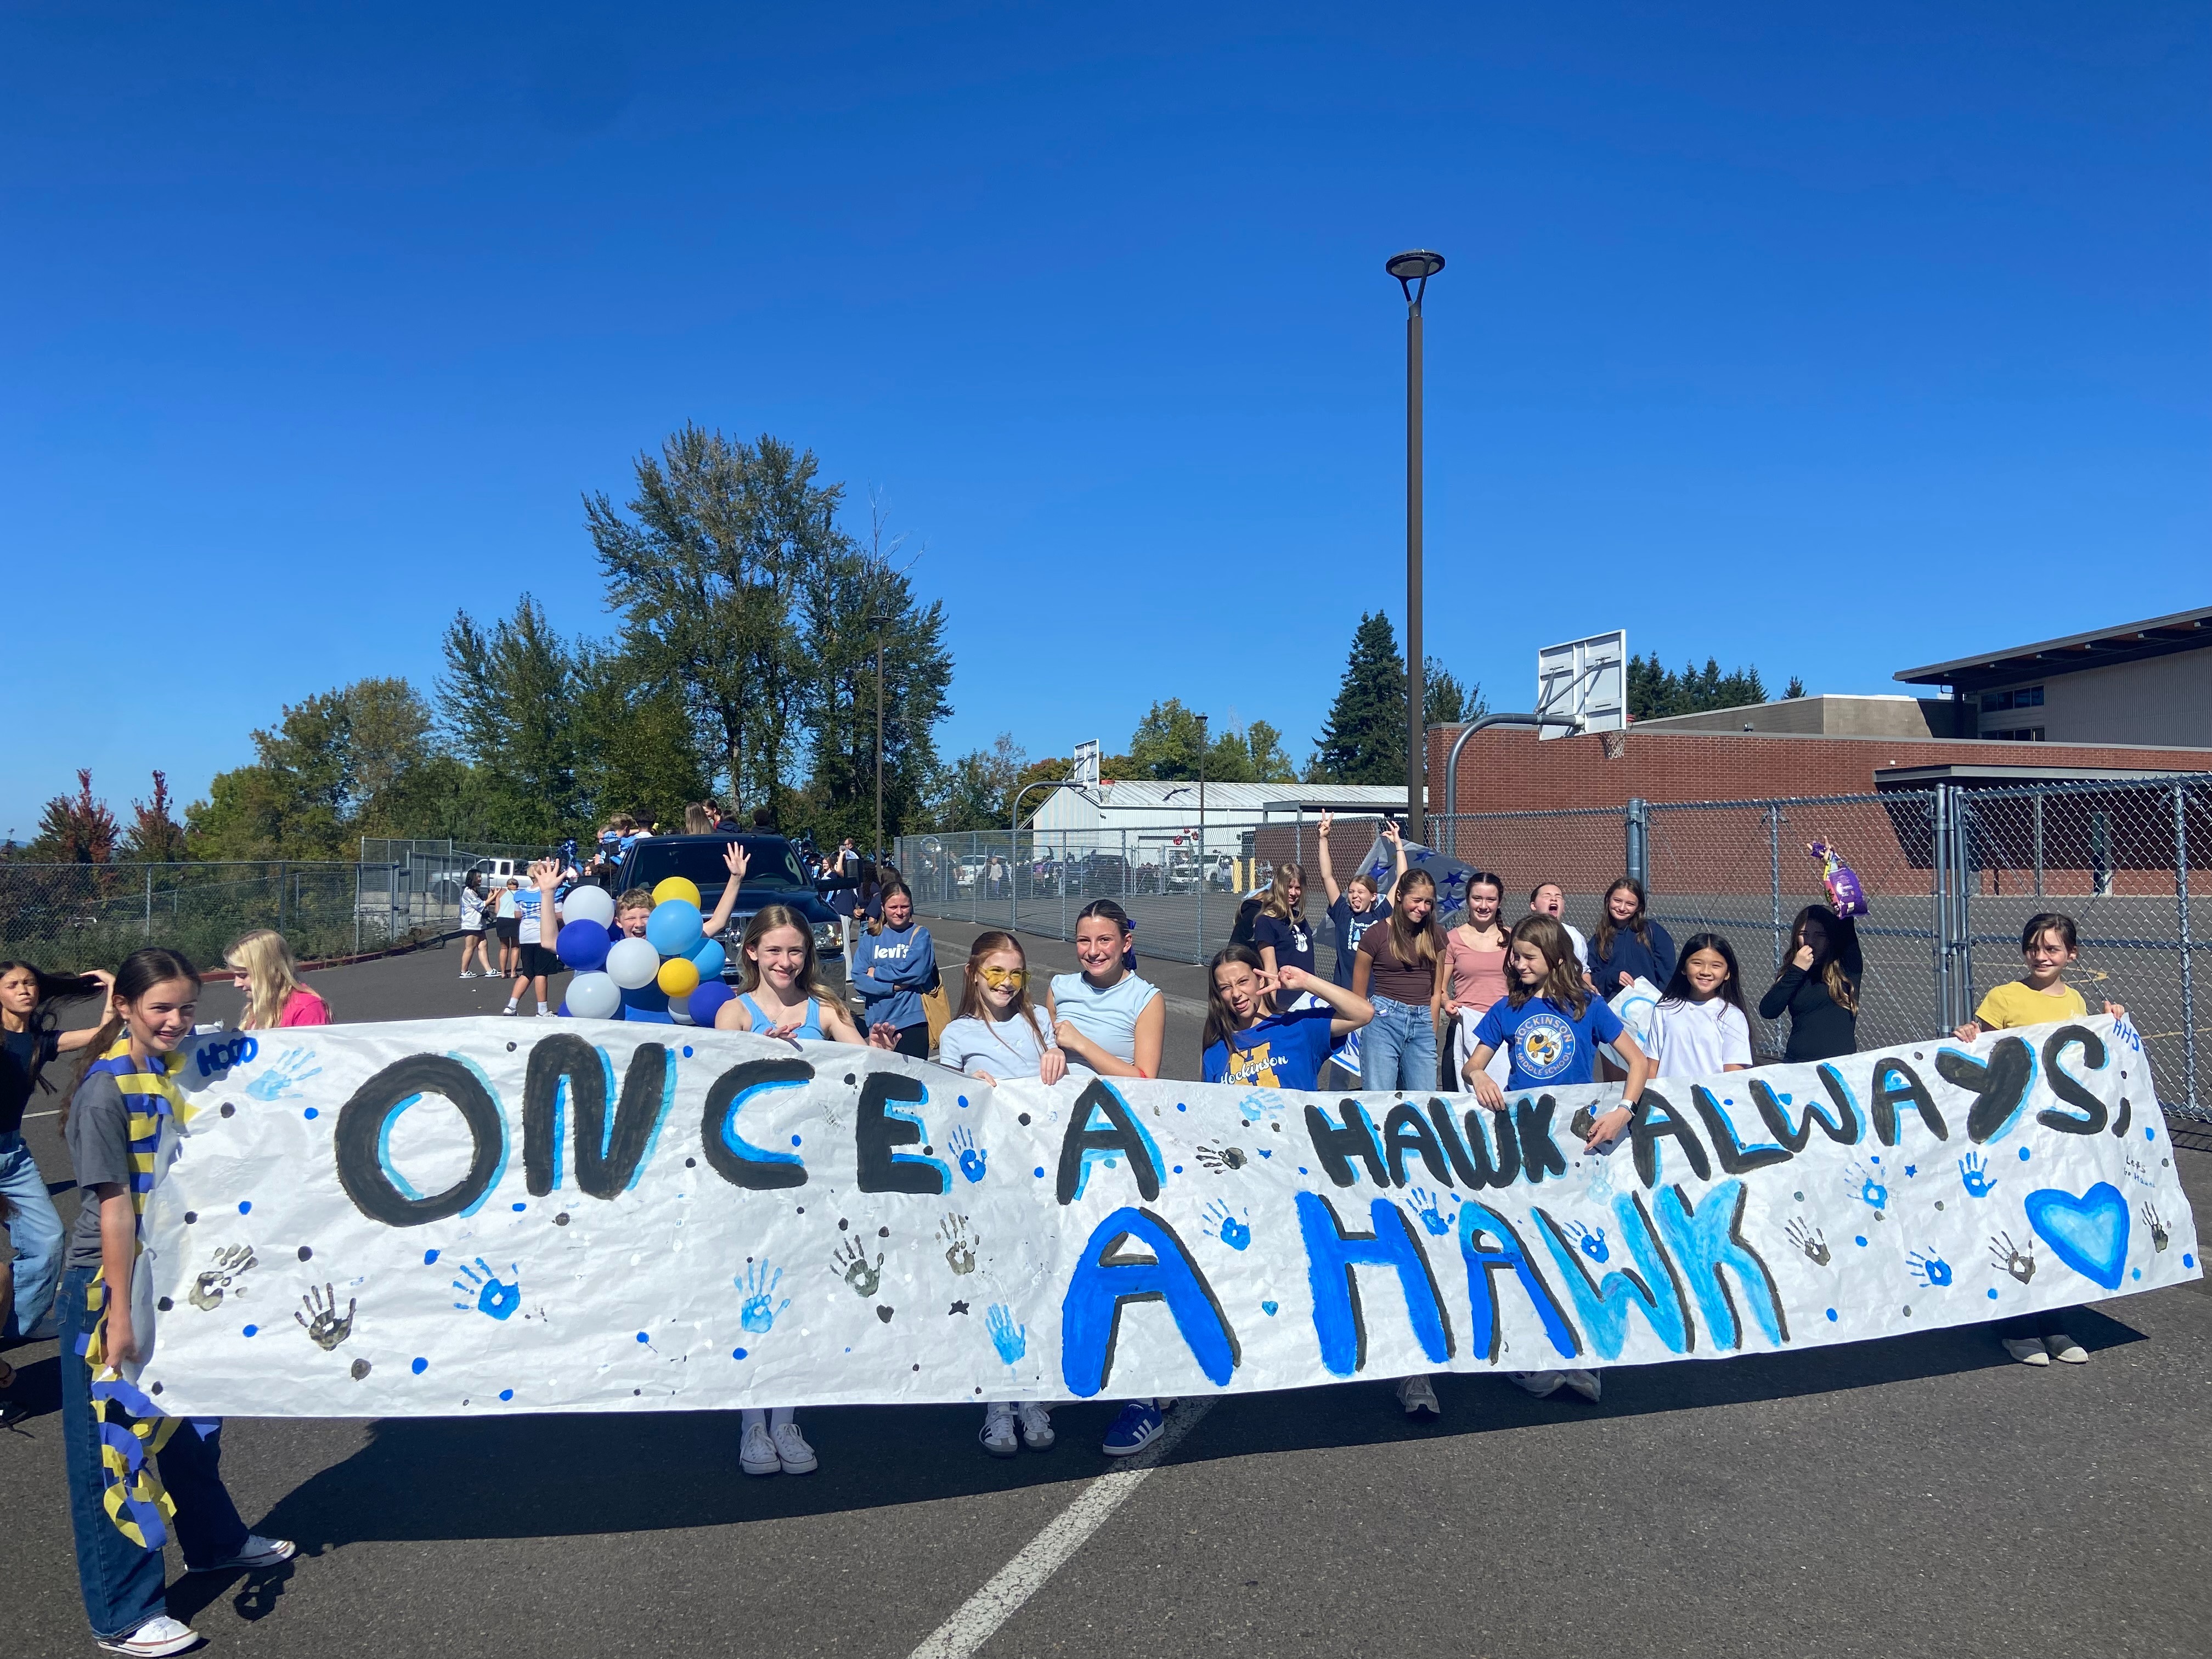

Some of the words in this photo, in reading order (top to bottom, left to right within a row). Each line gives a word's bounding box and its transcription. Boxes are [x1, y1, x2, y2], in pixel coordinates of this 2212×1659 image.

[1515, 1017, 1572, 1045] HOCKINSON
[1220, 1056, 1289, 1085] Hockinson
[1517, 1052, 1542, 1075] MIDDLE
[1544, 1051, 1572, 1075] SCHOOL
[335, 1032, 953, 1227] ONCE
[1057, 1079, 1167, 1205] A
[1304, 1093, 1569, 1192] HAWK
[1062, 1206, 1242, 1397] A
[1296, 1178, 1791, 1378] HAWK
